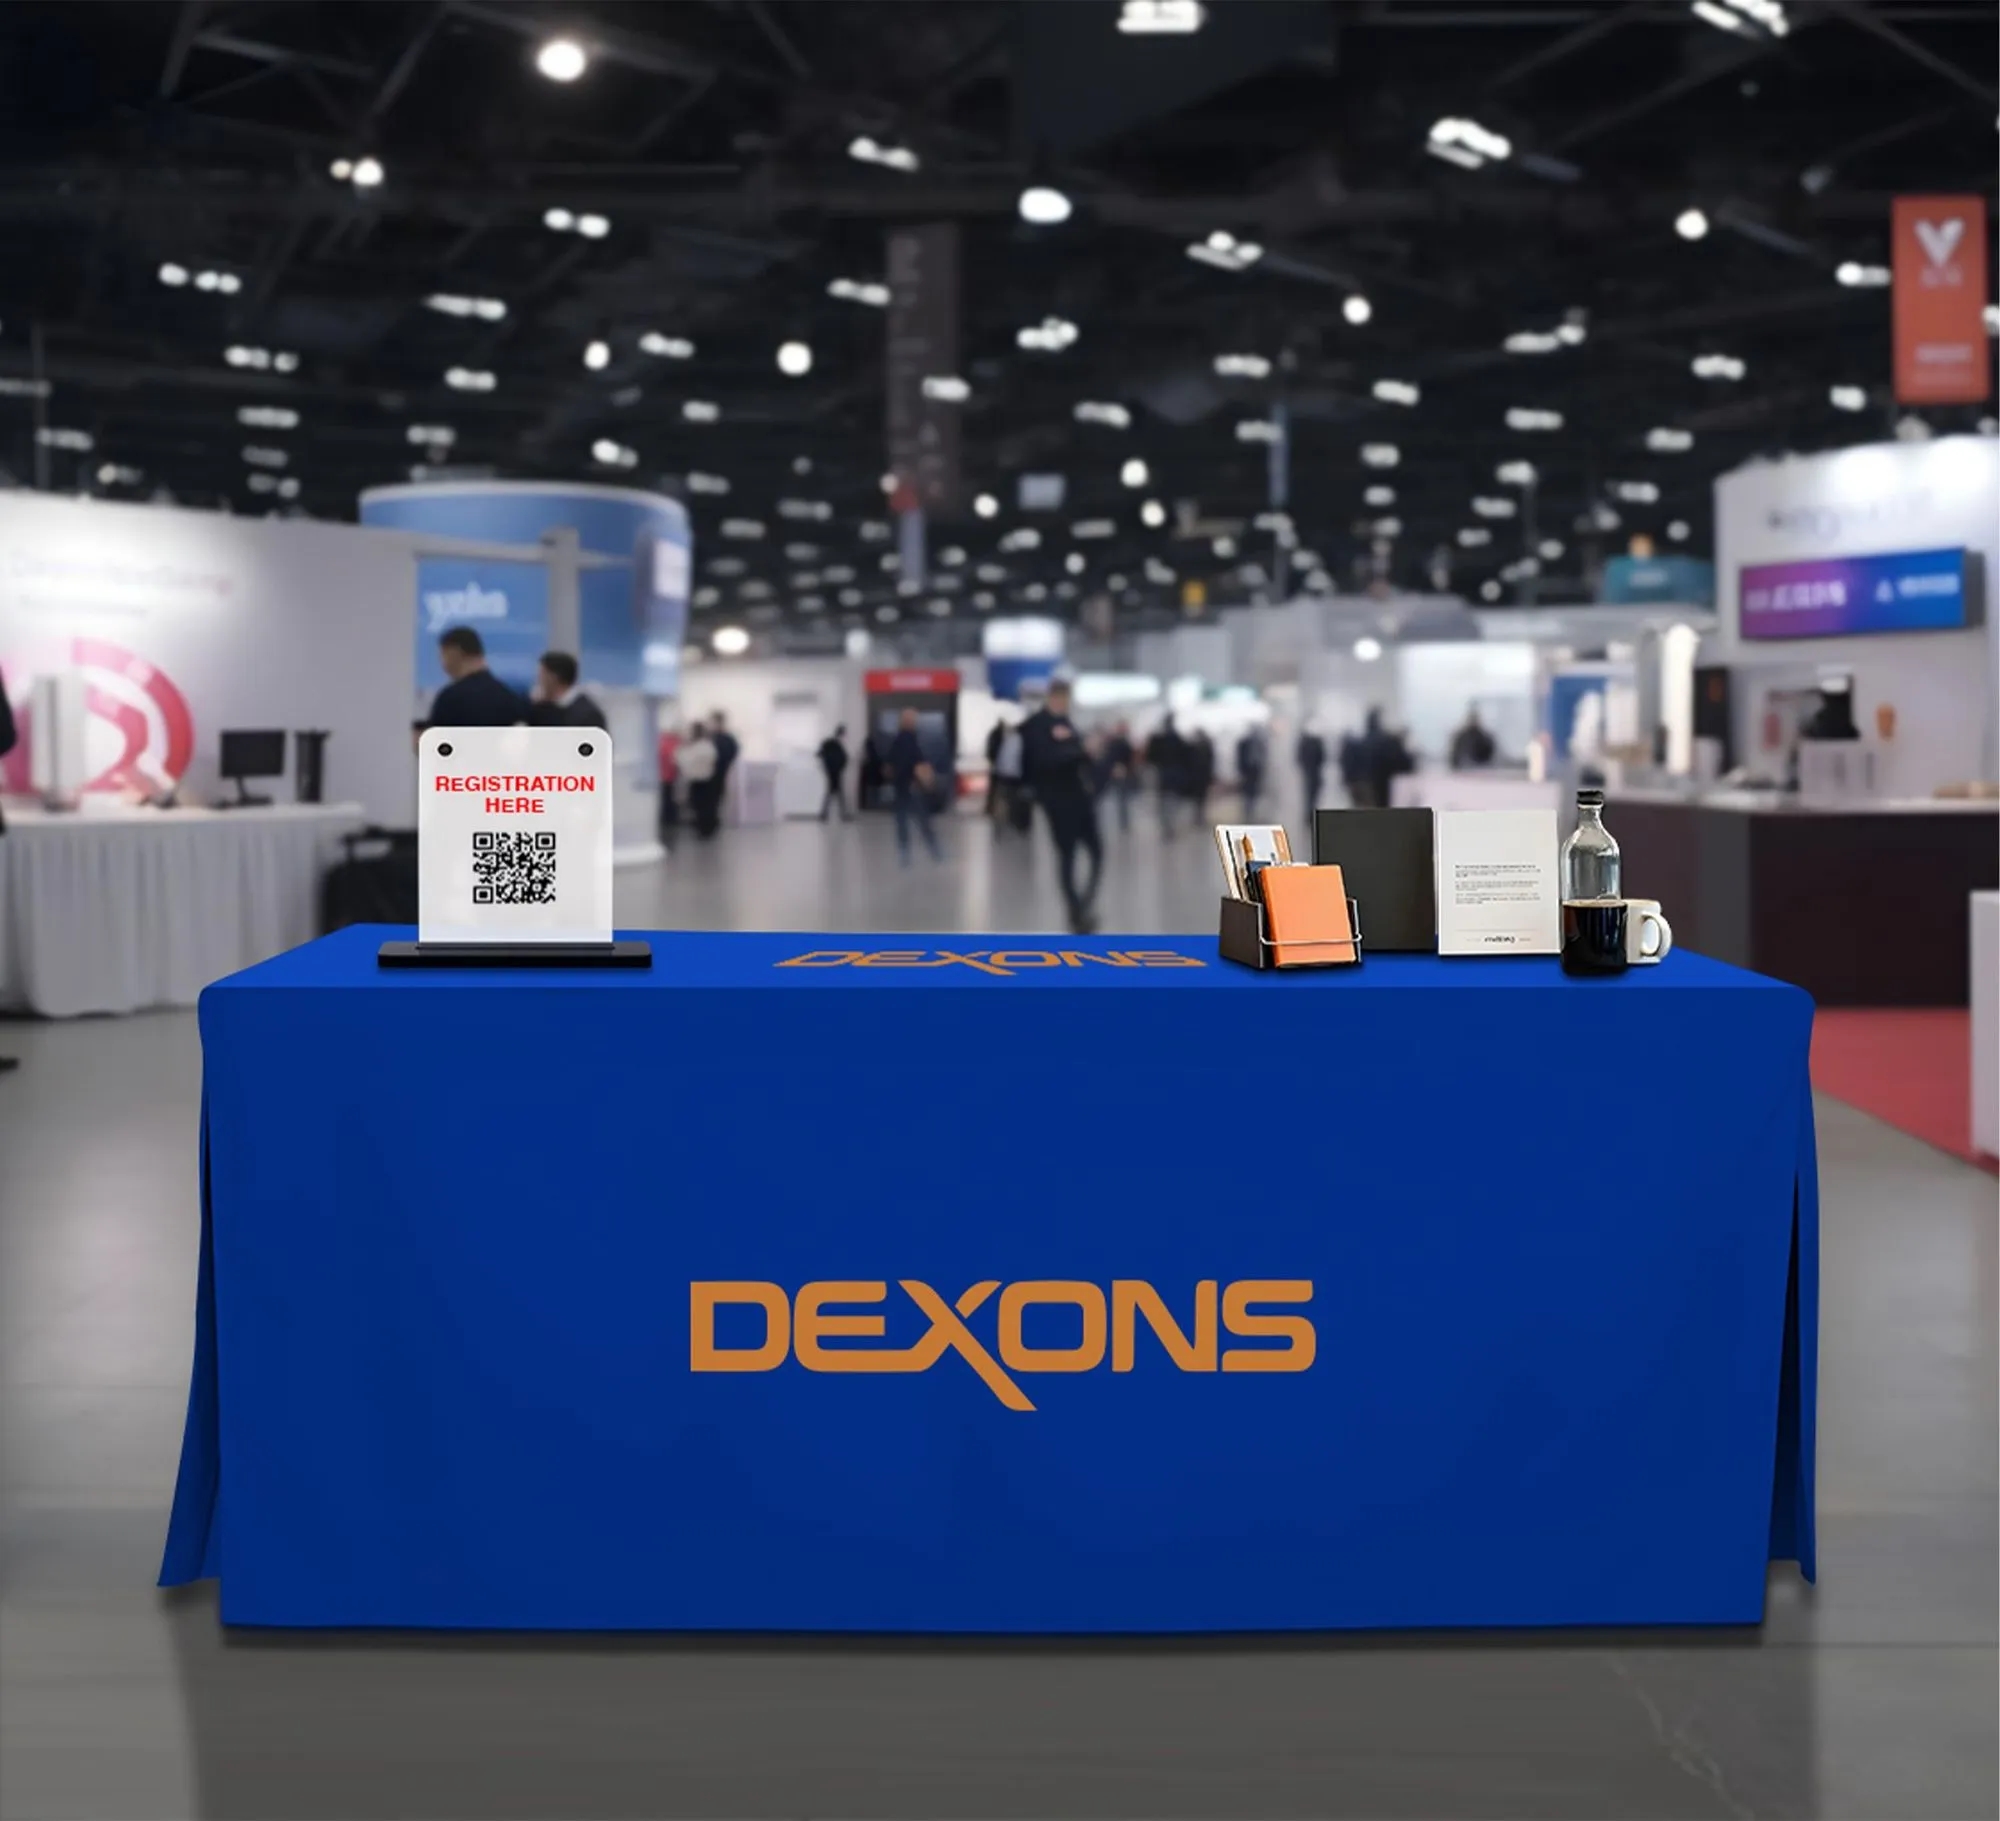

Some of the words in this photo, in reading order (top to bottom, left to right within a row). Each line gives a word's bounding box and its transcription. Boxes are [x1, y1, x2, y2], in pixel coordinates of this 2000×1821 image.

[434, 775, 596, 792] REGISTRATION
[485, 797, 544, 814] HERE
[773, 951, 1208, 976] DEXONS
[690, 1279, 1317, 1411] DEXONS
